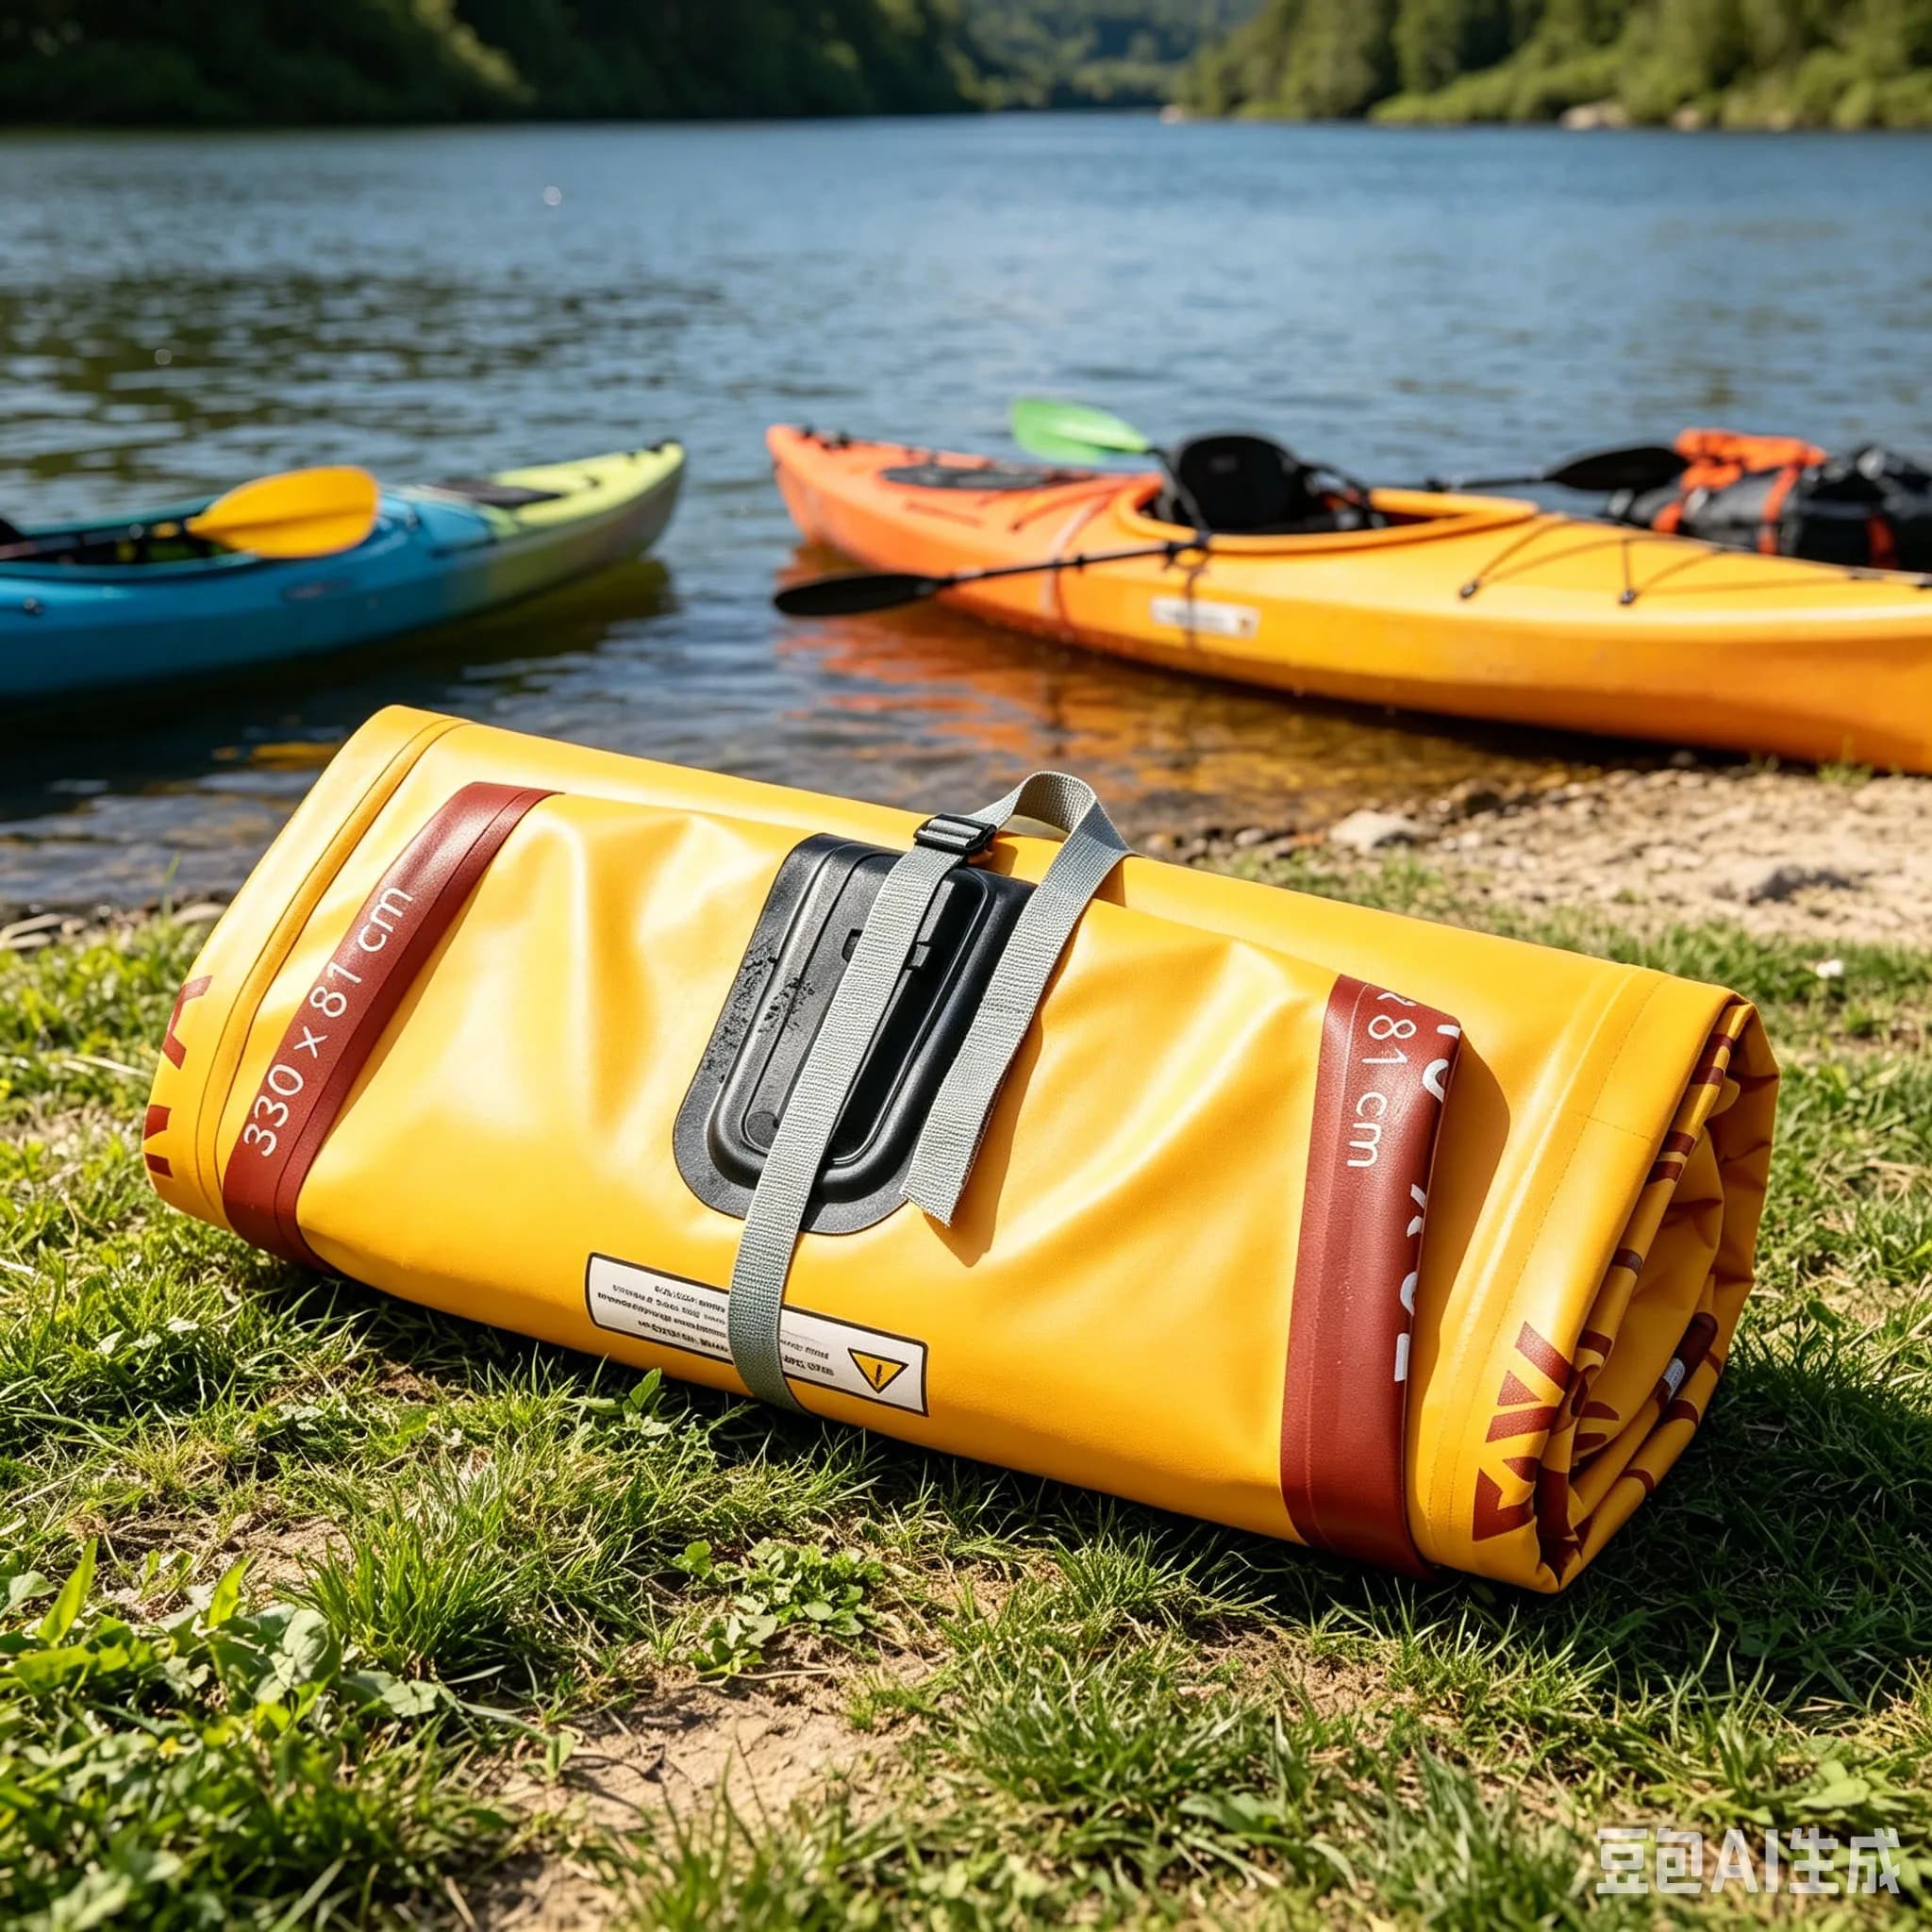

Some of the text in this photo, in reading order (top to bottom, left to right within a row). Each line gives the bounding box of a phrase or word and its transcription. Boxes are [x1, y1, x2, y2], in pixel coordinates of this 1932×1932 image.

[242, 1063, 304, 1157] 330
[308, 961, 362, 1018] 81
[357, 887, 414, 953] cm
[1360, 1013, 1417, 1067] 81
[1346, 1091, 1388, 1169] cm
